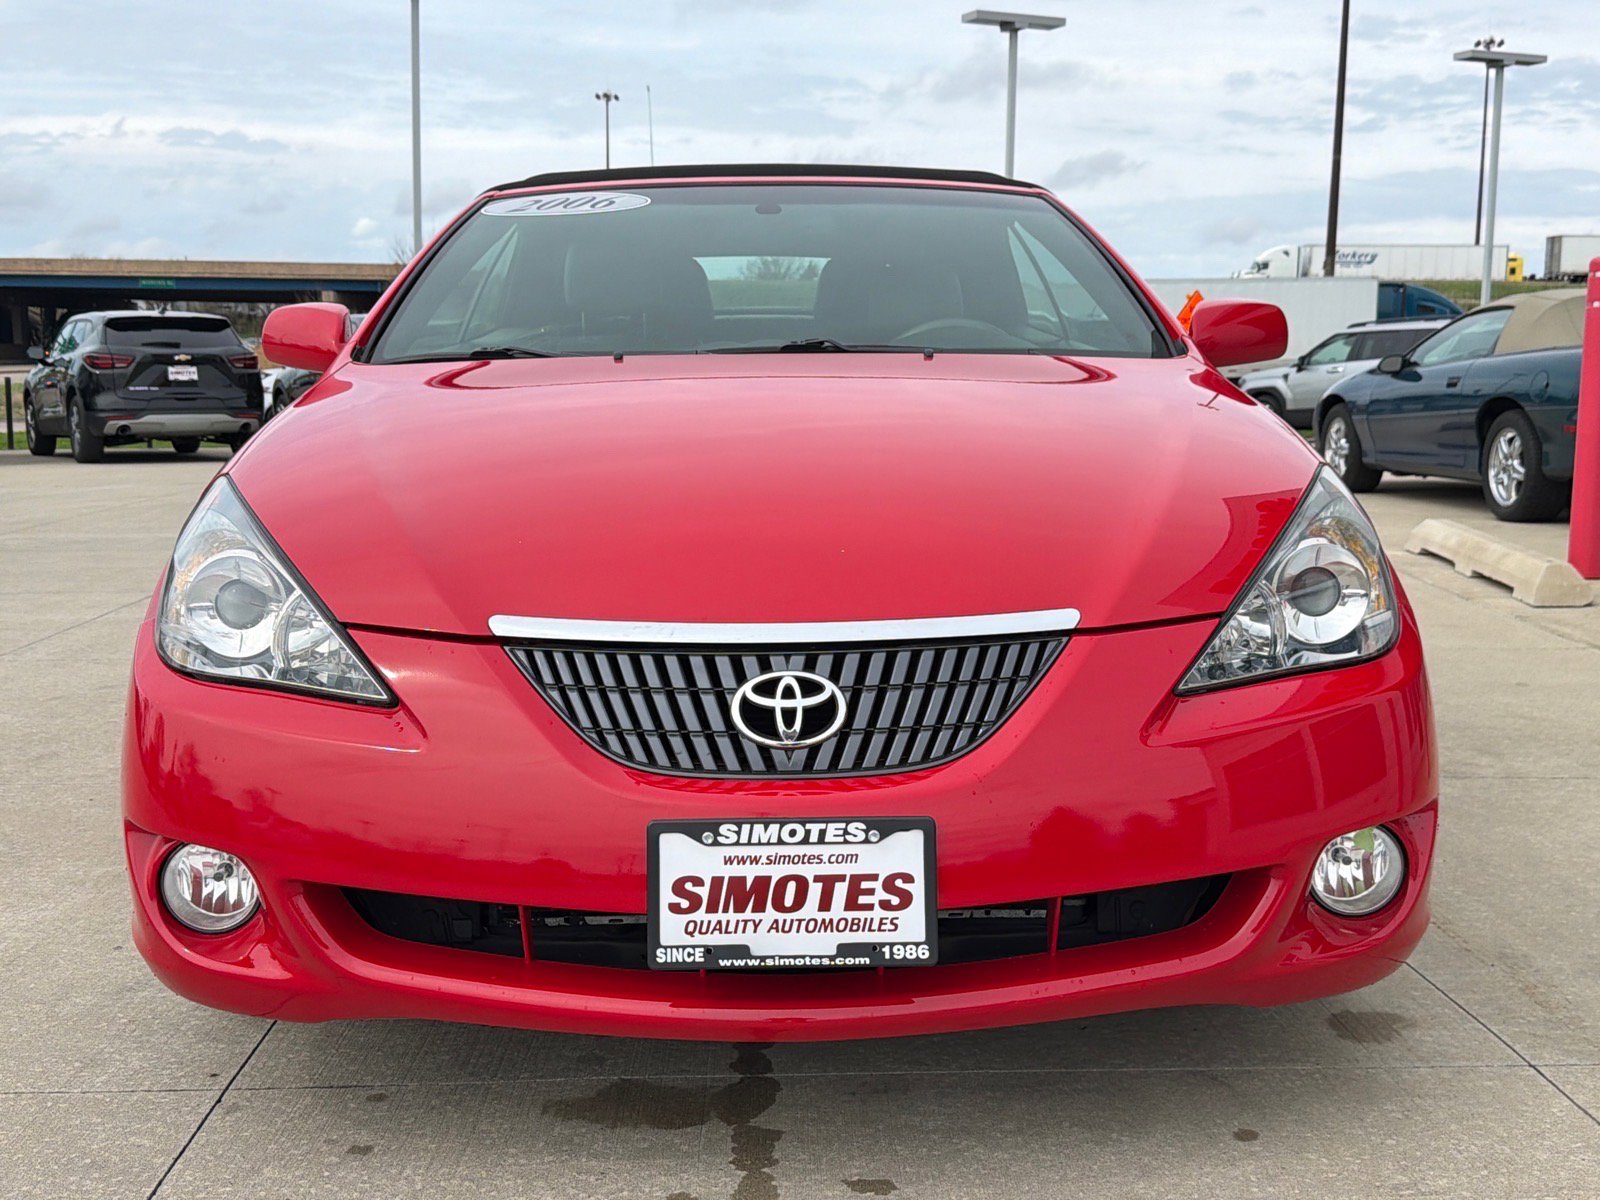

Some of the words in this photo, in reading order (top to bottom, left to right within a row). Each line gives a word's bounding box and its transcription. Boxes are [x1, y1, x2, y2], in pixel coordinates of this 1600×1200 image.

[506, 194, 626, 213] 2006
[717, 822, 867, 844] SIMOTES
[723, 852, 859, 866] www.simotes.com
[667, 872, 915, 915] SIMOTES
[684, 919, 763, 938] QUALITY
[767, 917, 899, 934] AUTOMOBILES
[656, 948, 705, 963] SINCE
[881, 944, 930, 960] 1986
[718, 956, 870, 967] www.simotes.com
